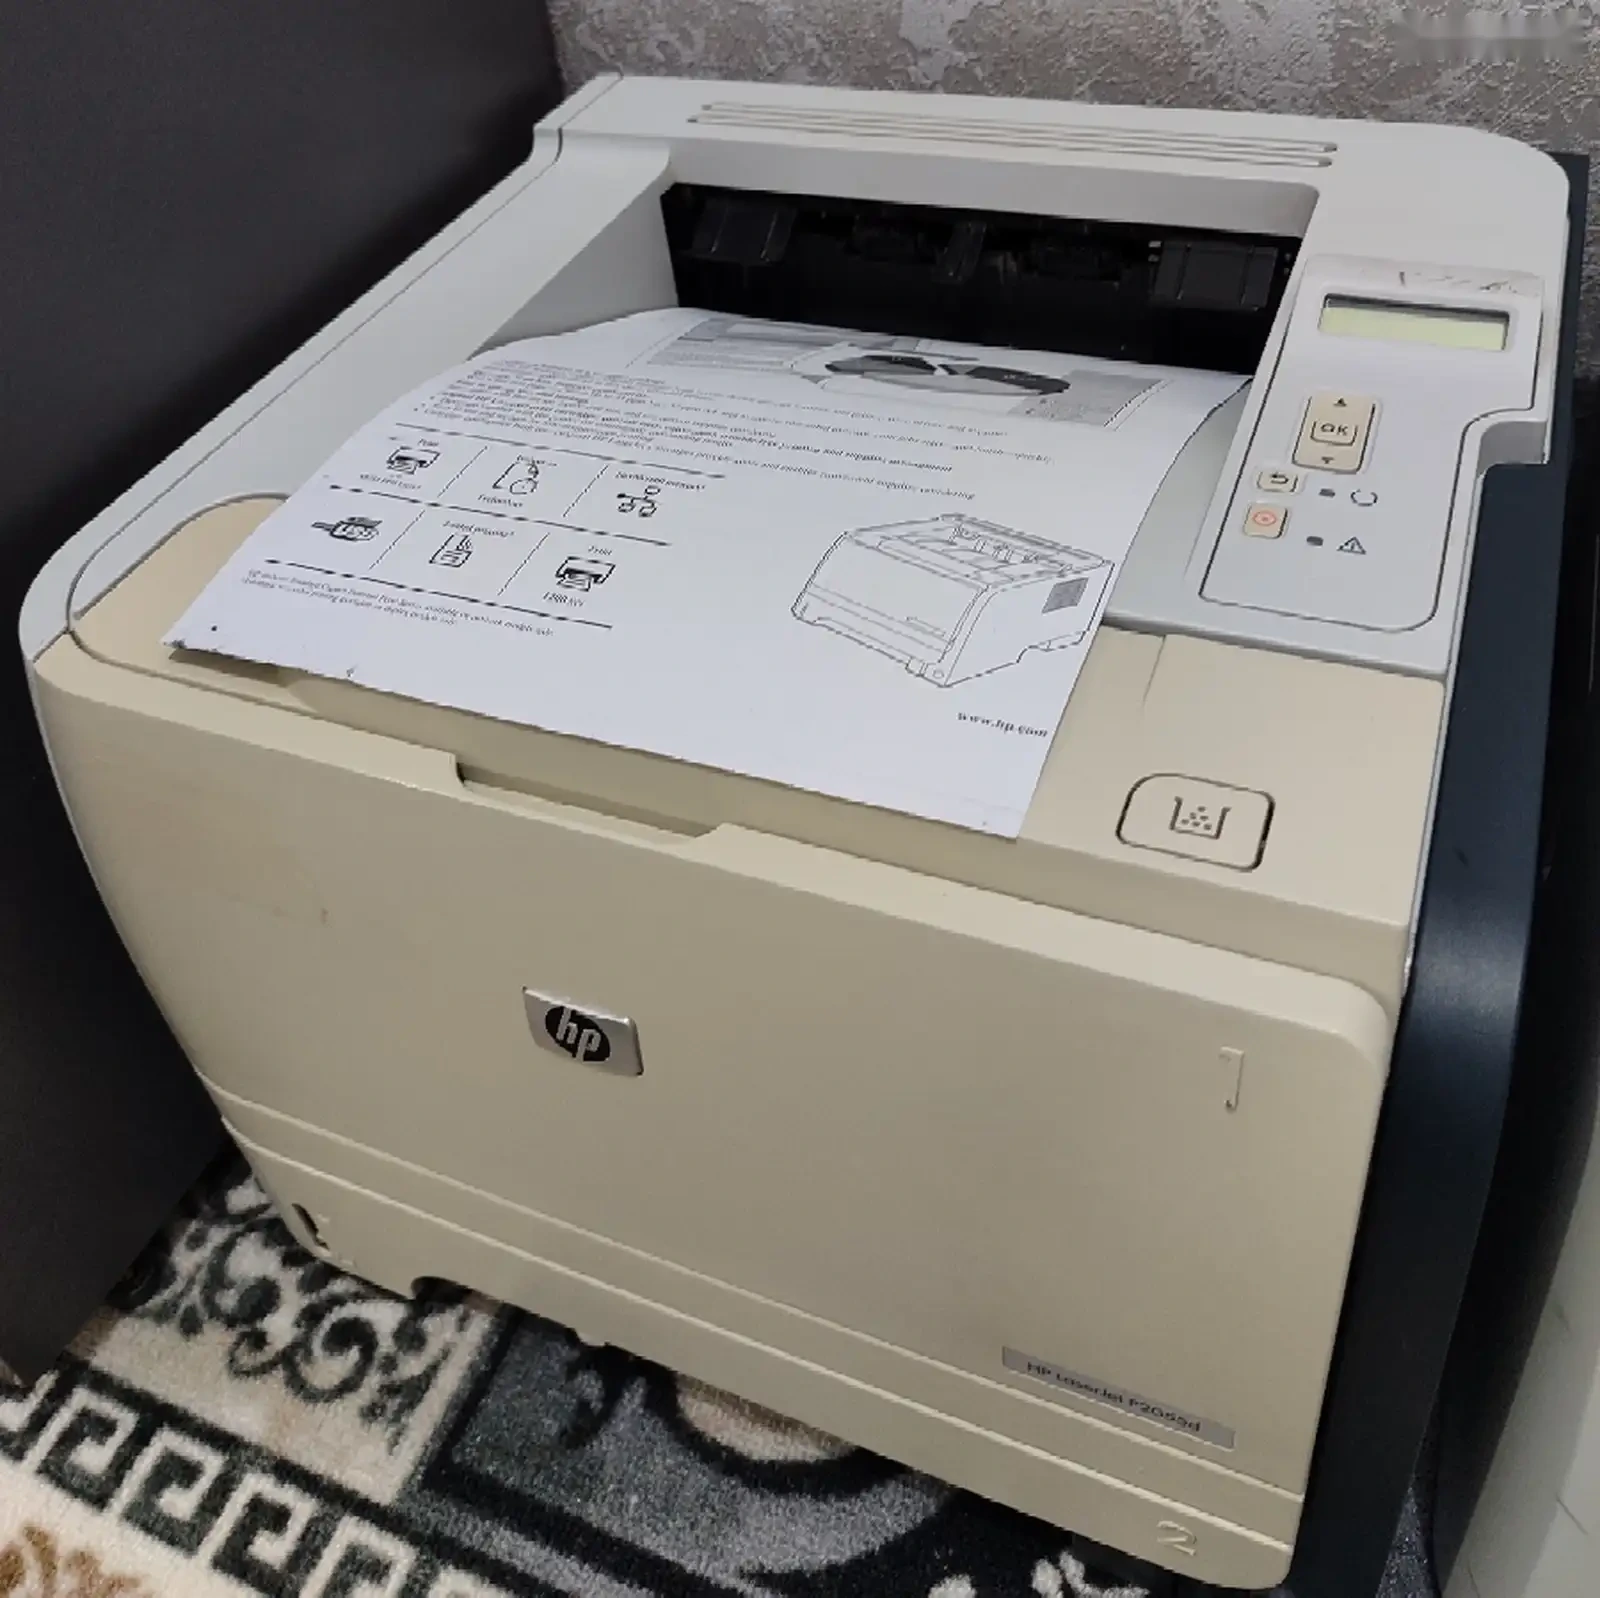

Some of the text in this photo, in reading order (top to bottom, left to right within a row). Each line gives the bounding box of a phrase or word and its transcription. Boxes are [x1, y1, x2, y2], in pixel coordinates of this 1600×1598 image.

[1320, 422, 1348, 436] OK
[957, 712, 1048, 738] www.hp.com
[555, 1005, 601, 1062] hp
[1027, 1360, 1052, 1376] HP
[1056, 1373, 1124, 1404] LaserJet
[1156, 1520, 1197, 1556] 2
